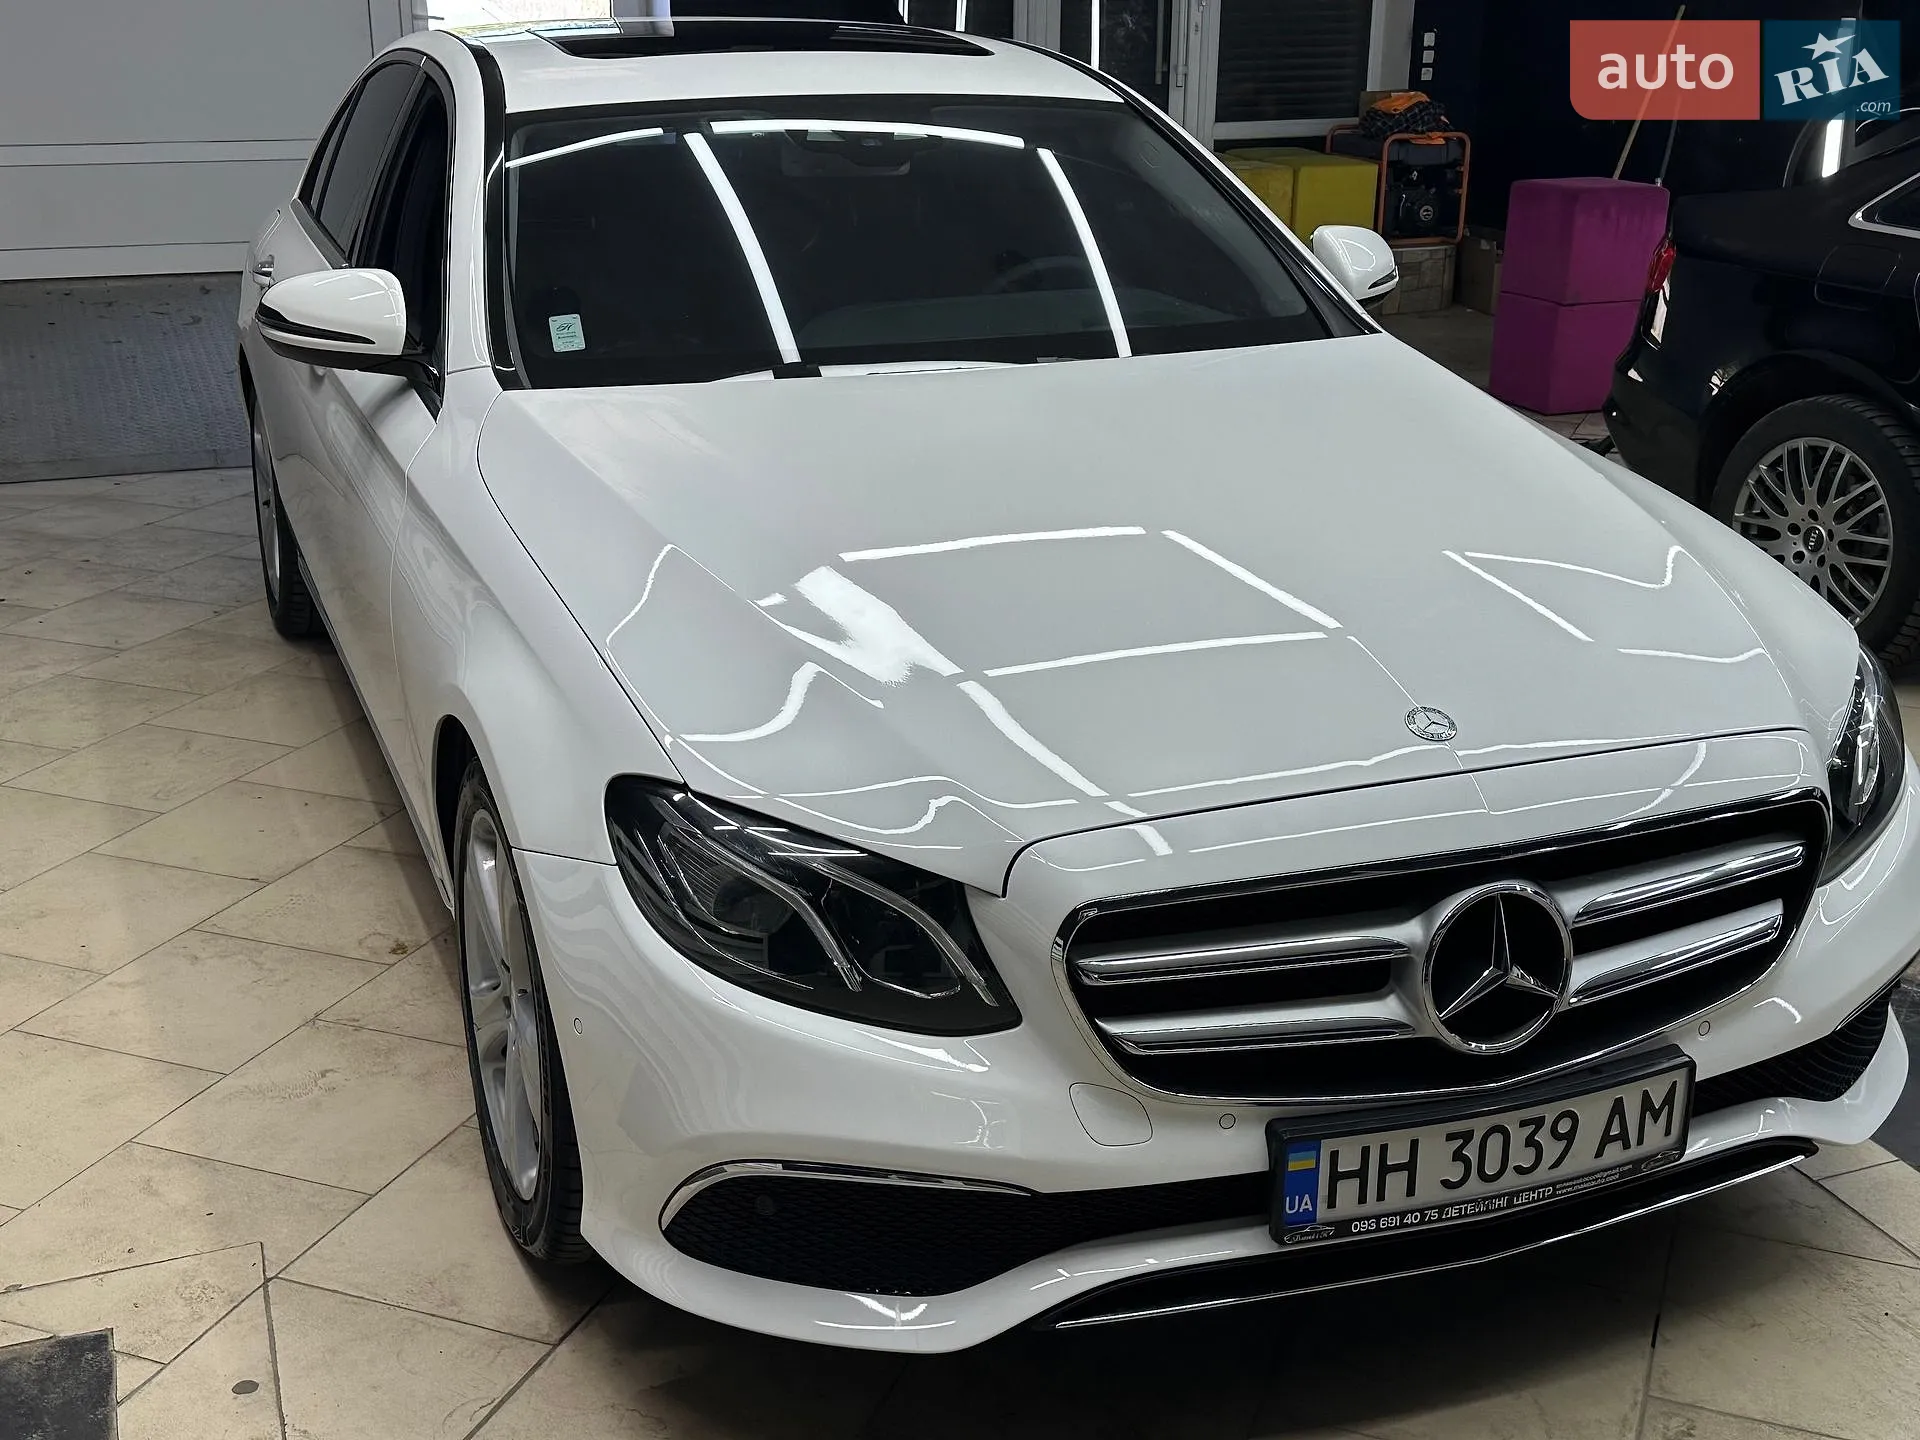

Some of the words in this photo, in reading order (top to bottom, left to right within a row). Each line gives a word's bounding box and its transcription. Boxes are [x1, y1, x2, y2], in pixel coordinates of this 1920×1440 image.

[1326, 1138, 1420, 1209] HH
[1440, 1109, 1580, 1190] 3039
[1594, 1080, 1678, 1159] AM
[1285, 1194, 1313, 1214] UA
[1351, 1219, 1377, 1233] 093
[1379, 1215, 1400, 1229] 691
[1403, 1212, 1420, 1225] 40
[1424, 1209, 1439, 1222] 75
[1513, 1186, 1553, 1204] ЦЕНТР
